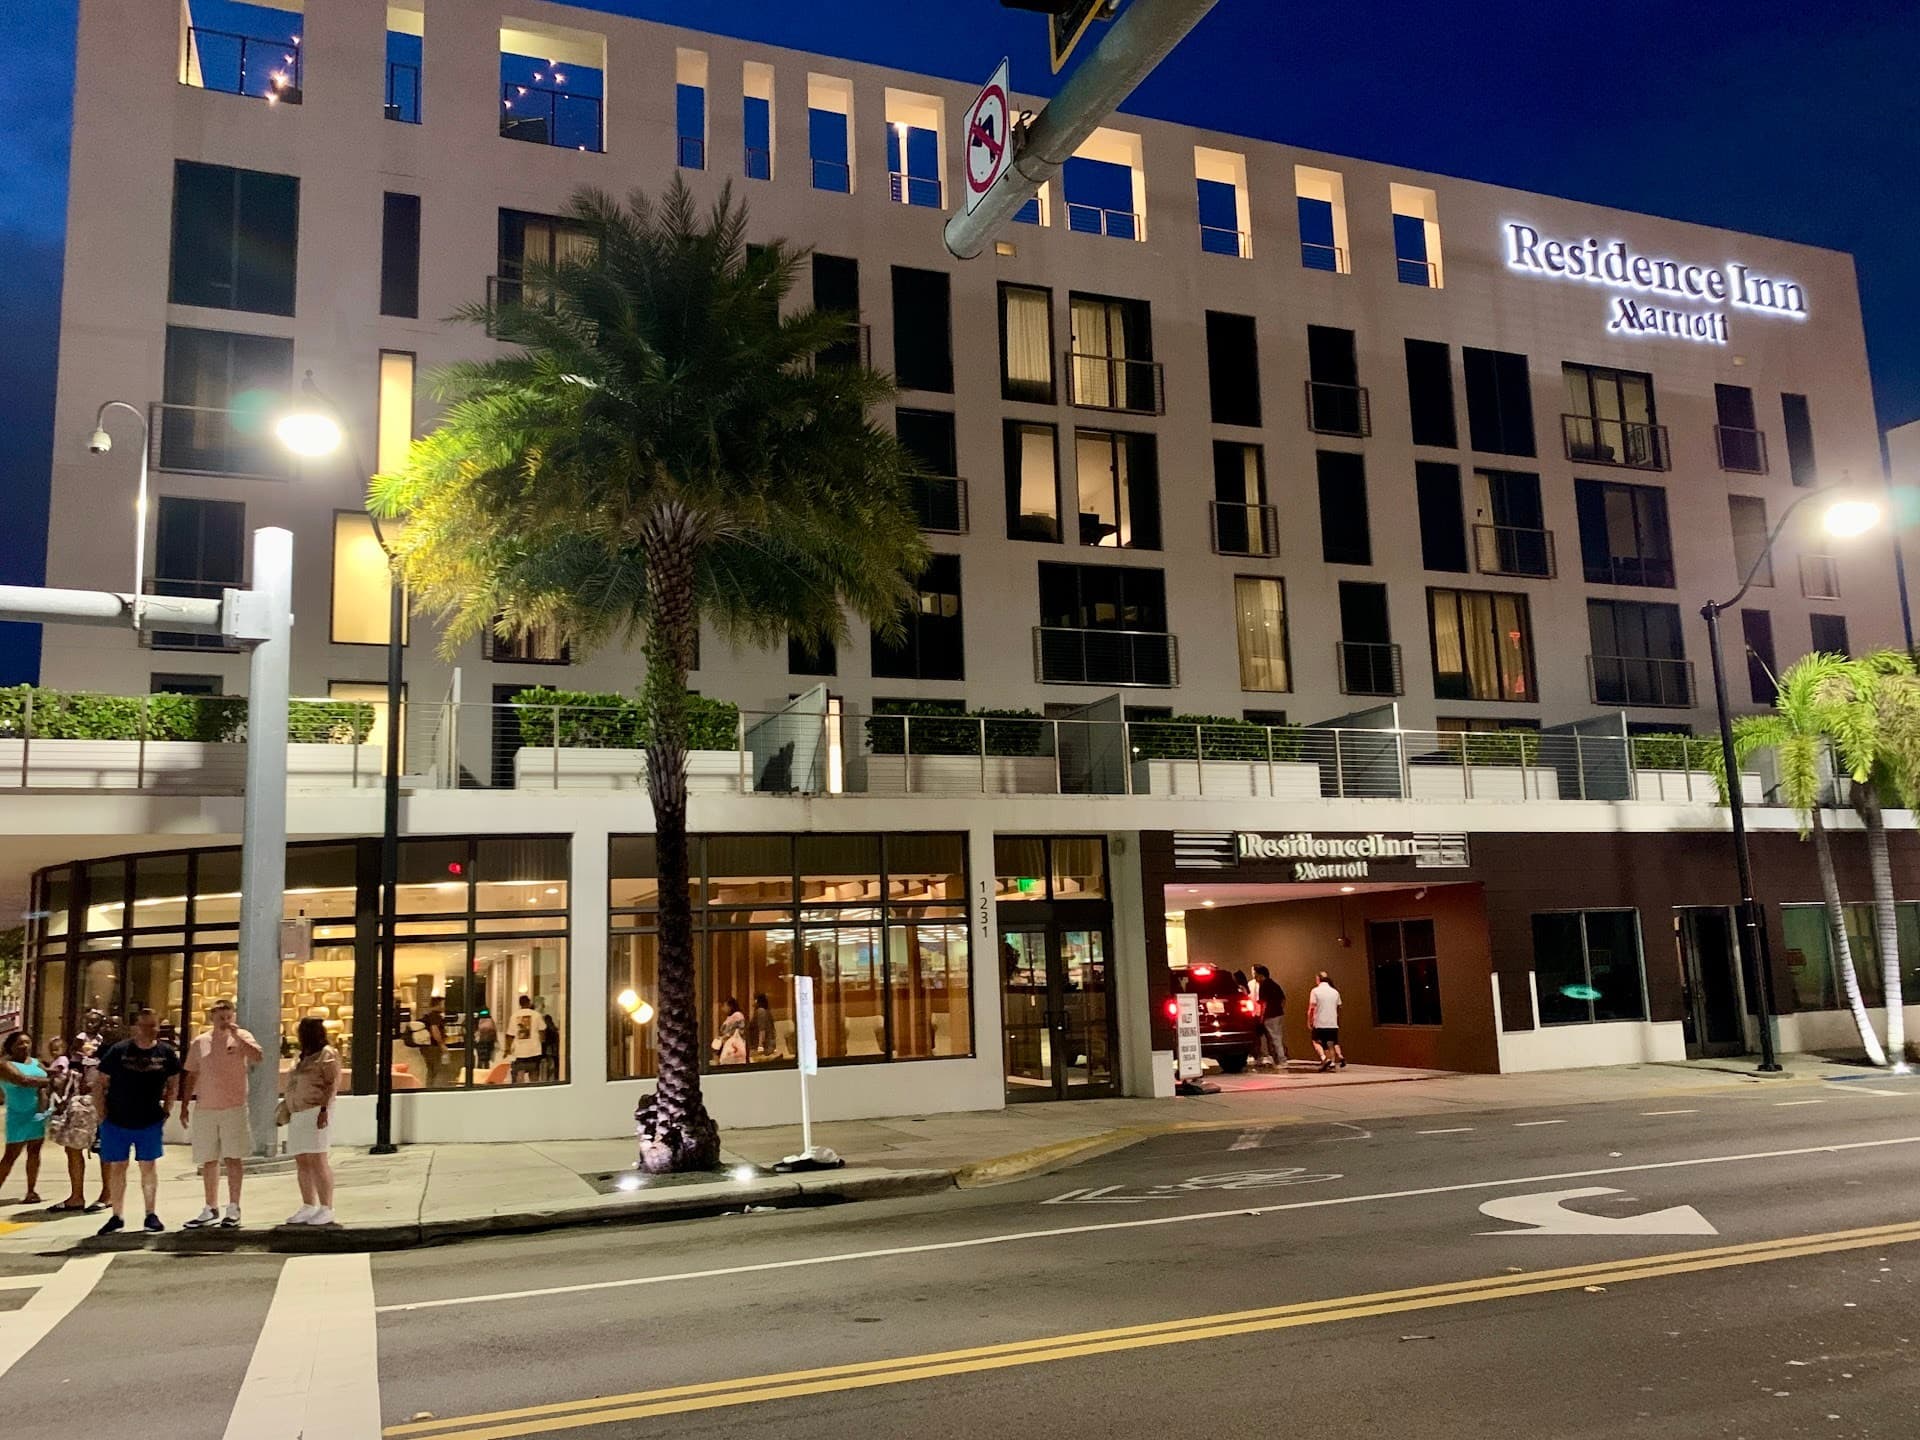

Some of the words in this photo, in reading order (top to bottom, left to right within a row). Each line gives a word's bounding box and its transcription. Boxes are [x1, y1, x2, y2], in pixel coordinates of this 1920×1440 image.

[1507, 223, 1727, 300] Residence
[1731, 263, 1807, 315] Inn
[1611, 298, 1729, 342] Marriott
[1239, 833, 1369, 857] Residence
[1370, 834, 1420, 856] Inn
[1294, 861, 1369, 881] Marriott
[979, 880, 989, 938] 1231
